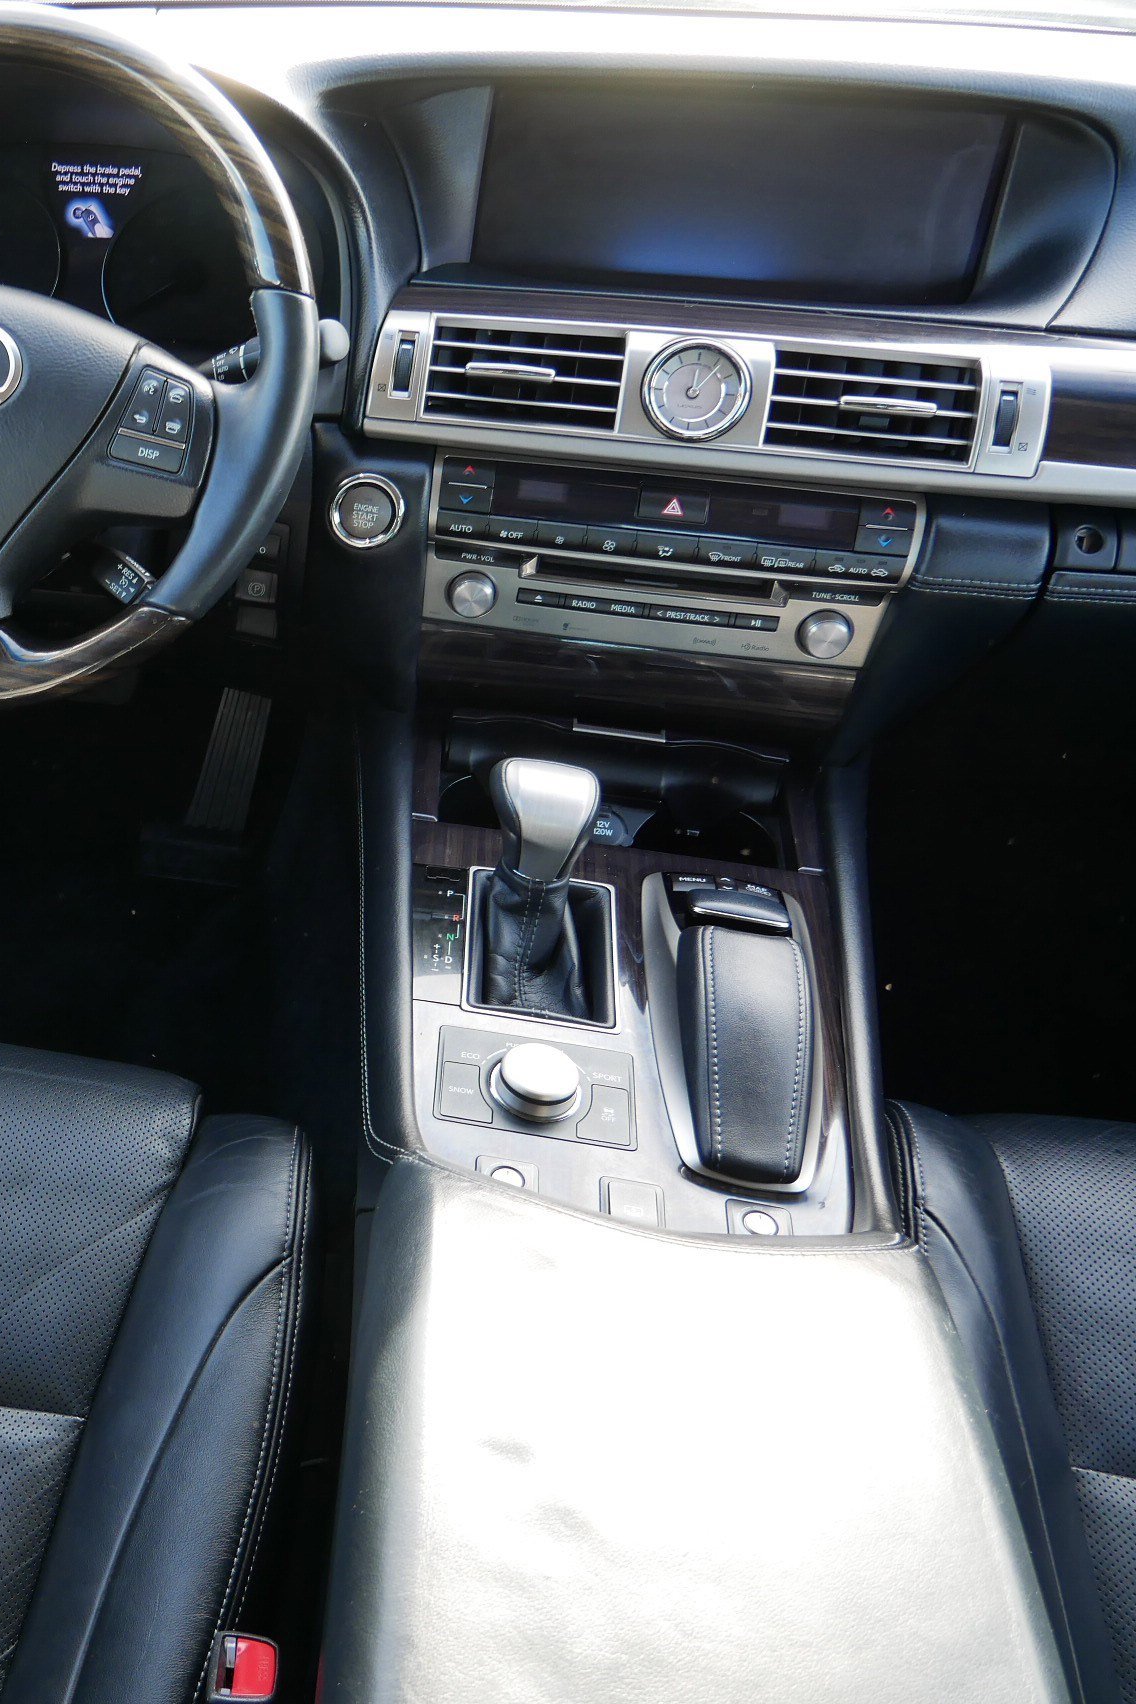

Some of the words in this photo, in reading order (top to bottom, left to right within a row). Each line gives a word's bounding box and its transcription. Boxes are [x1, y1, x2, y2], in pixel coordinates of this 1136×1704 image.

[51, 162, 82, 174] Depress
[83, 164, 96, 174] the
[96, 164, 118, 176] brake
[55, 173, 70, 182] and
[72, 173, 93, 183] touch
[95, 175, 107, 184] the
[109, 176, 135, 187] engine
[58, 183, 83, 192] switch
[84, 184, 101, 194] with
[102, 185, 115, 194] the
[116, 185, 131, 196] key
[137, 447, 160, 460] DISP
[353, 502, 380, 513] ENGINE
[352, 511, 379, 522] START
[353, 520, 374, 530] STOP
[449, 523, 473, 533] AUTO
[508, 531, 524, 540] OFF
[720, 554, 742, 563] FRONT
[787, 561, 804, 569] REAR
[121, 567, 135, 580] RES
[848, 567, 868, 575] AUTO
[109, 582, 123, 595] SET
[571, 600, 596, 609] RADIO
[610, 604, 635, 614] MEDIA
[751, 644, 770, 652] Radio
[596, 820, 610, 829] 12V
[593, 828, 613, 837] 120W
[452, 914, 460, 922] R
[461, 1051, 480, 1060] ECO
[592, 1071, 622, 1083] SPORT
[448, 1085, 474, 1095] SNOW
[600, 1114, 617, 1123] OFF
